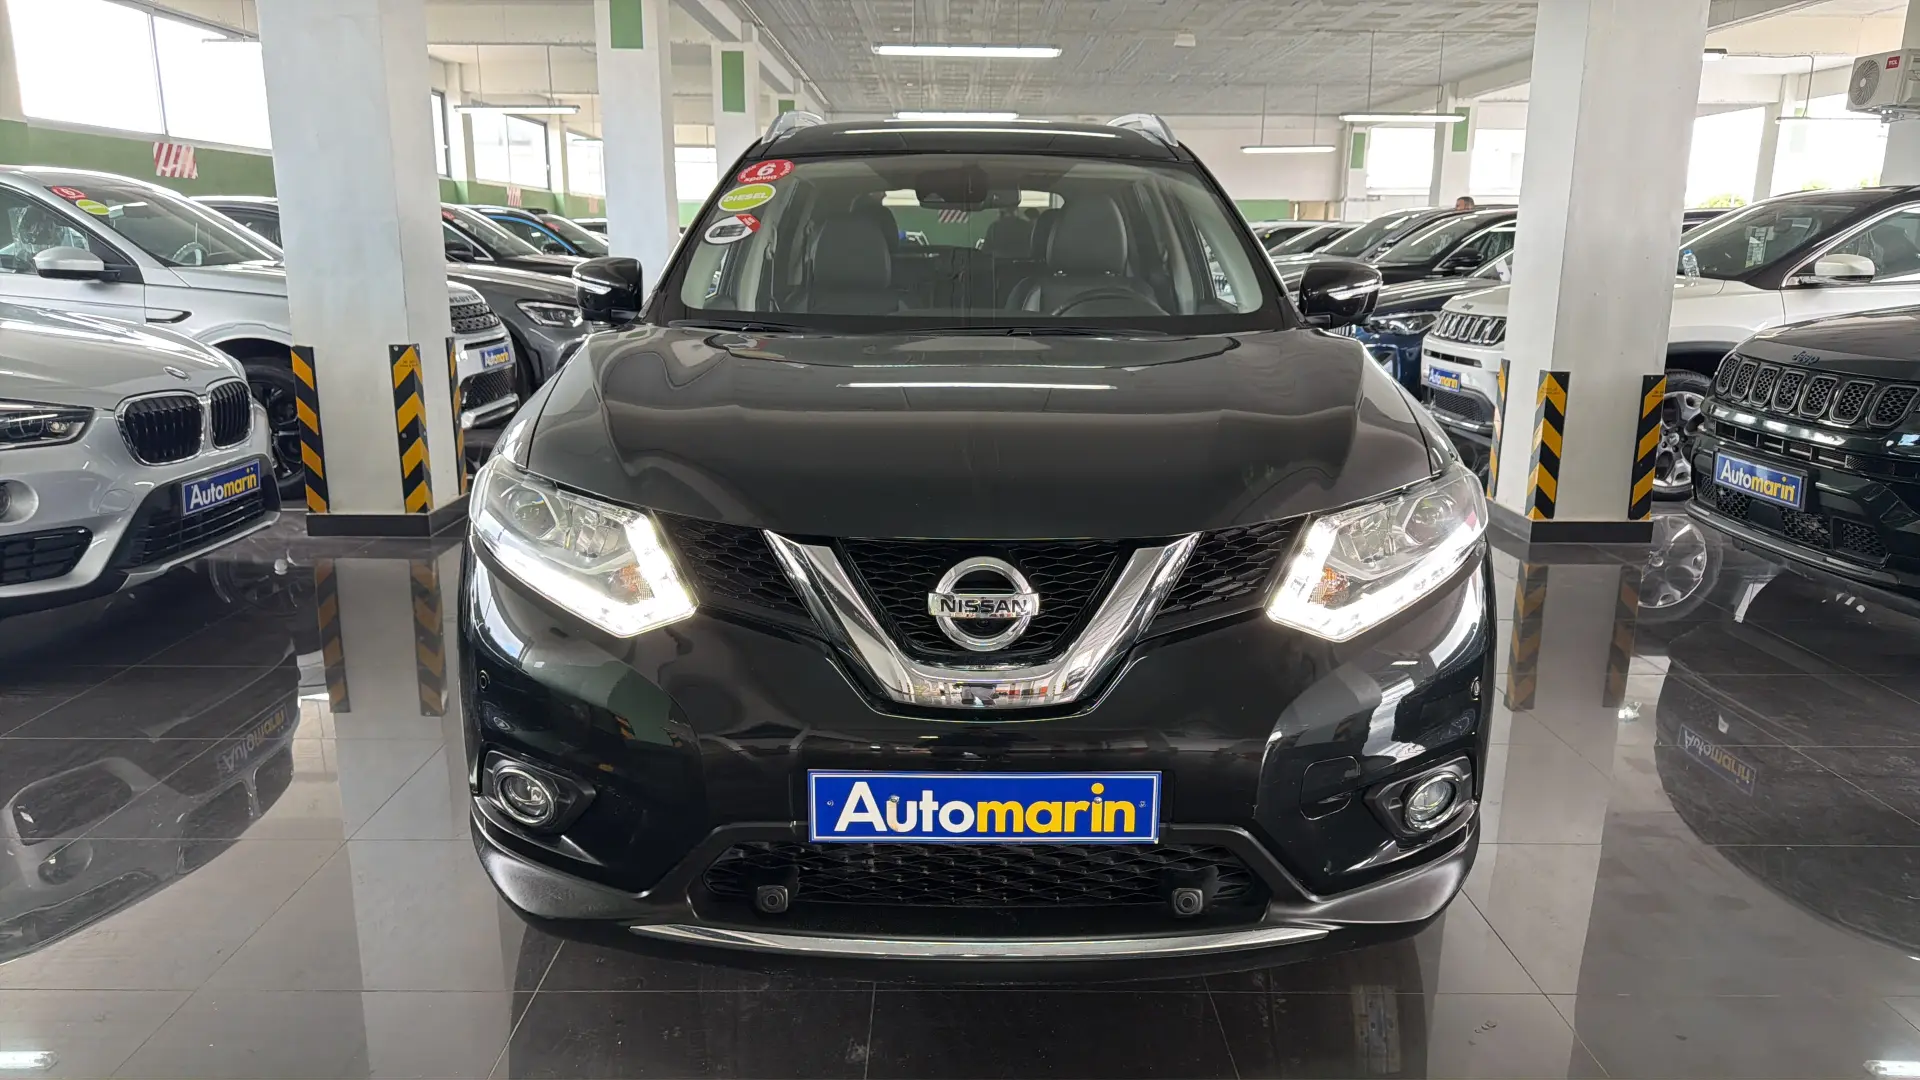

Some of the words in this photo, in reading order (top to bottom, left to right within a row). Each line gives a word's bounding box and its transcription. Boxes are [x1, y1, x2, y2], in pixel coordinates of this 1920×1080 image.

[757, 163, 776, 176] 6
[723, 192, 768, 202] DIESEL
[190, 467, 257, 510] Automarin
[1720, 459, 1795, 501] Automarin
[940, 599, 1027, 613] NISSAN
[834, 781, 1136, 833] Automarin
